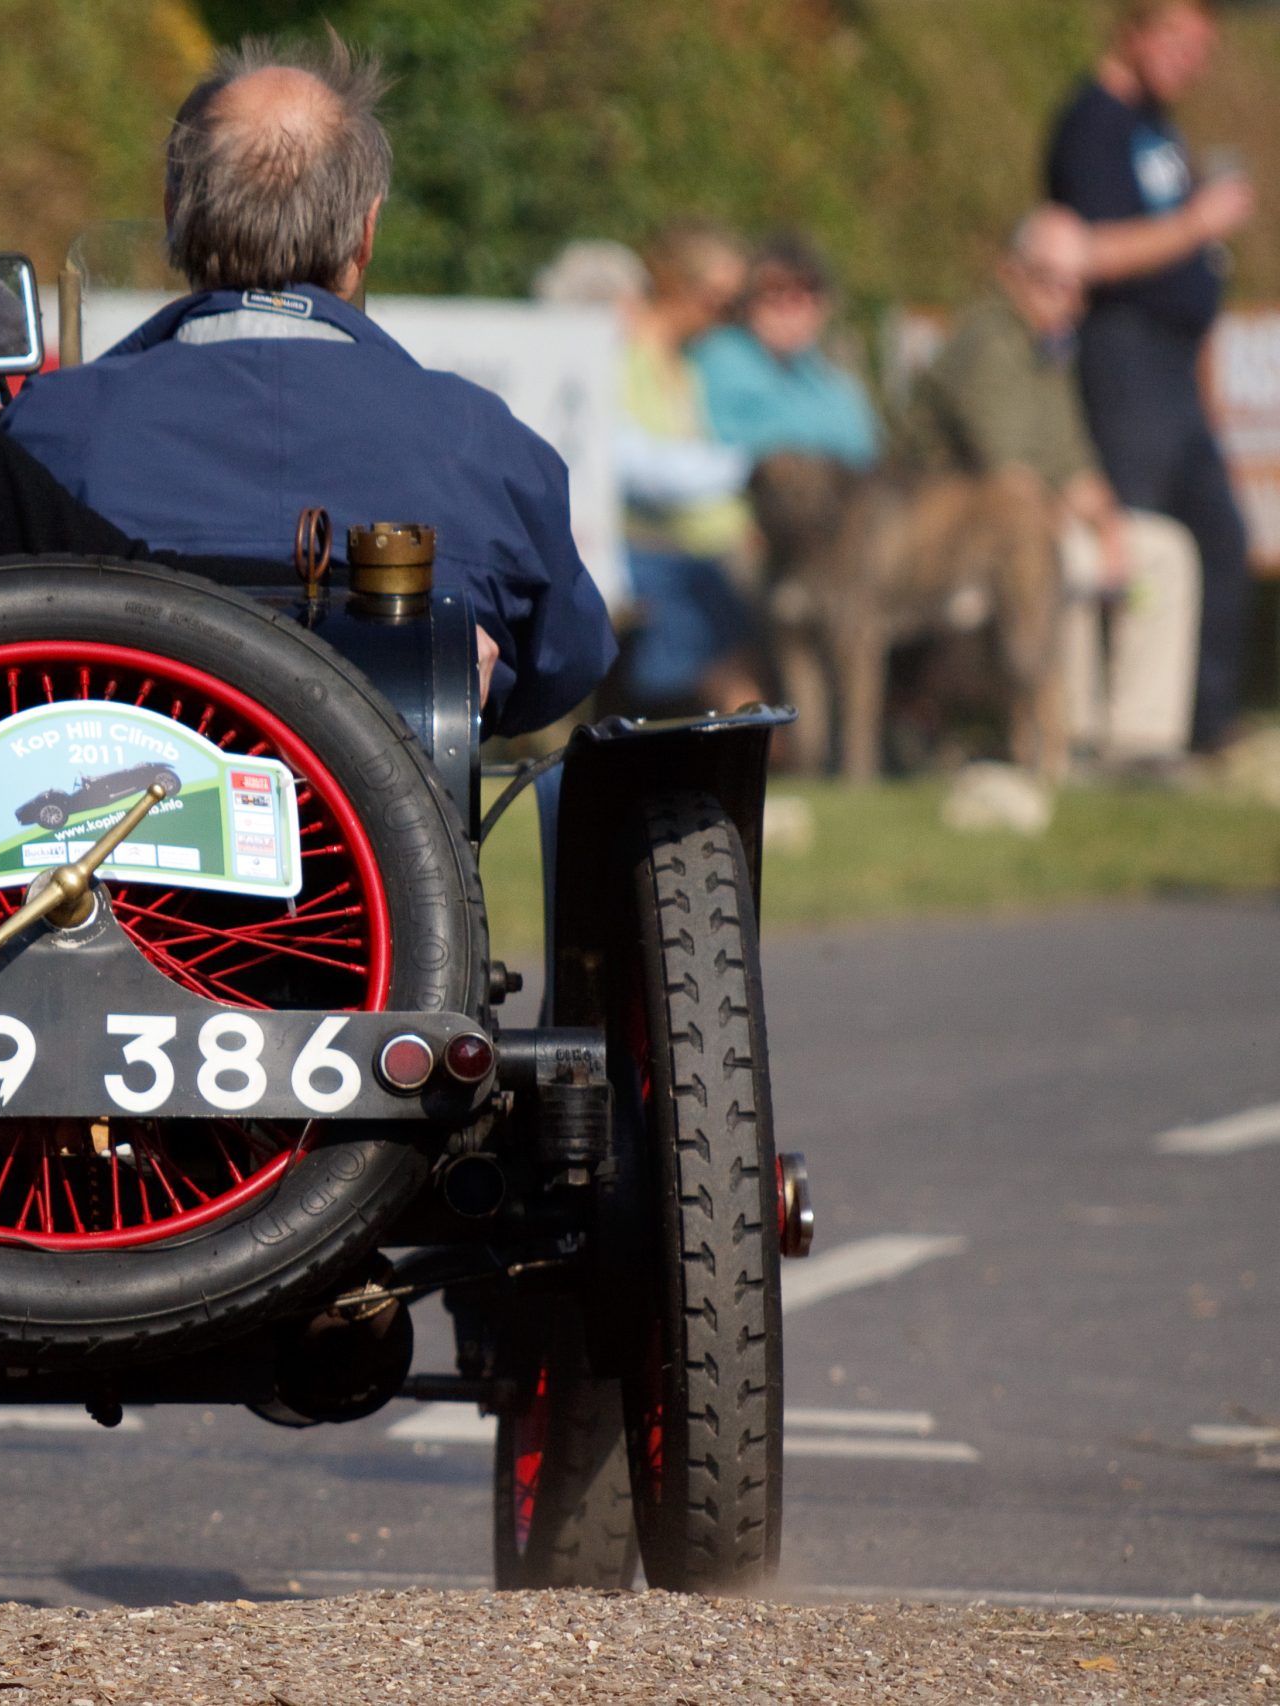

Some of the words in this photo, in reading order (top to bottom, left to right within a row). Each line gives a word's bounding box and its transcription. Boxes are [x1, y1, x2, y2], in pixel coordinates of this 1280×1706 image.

[10, 729, 60, 758] Kop
[65, 720, 103, 740] Hill
[108, 723, 180, 761] Climb
[68, 744, 124, 766] 2011
[103, 1012, 363, 1113] 386
[249, 1140, 386, 1246] ORD
